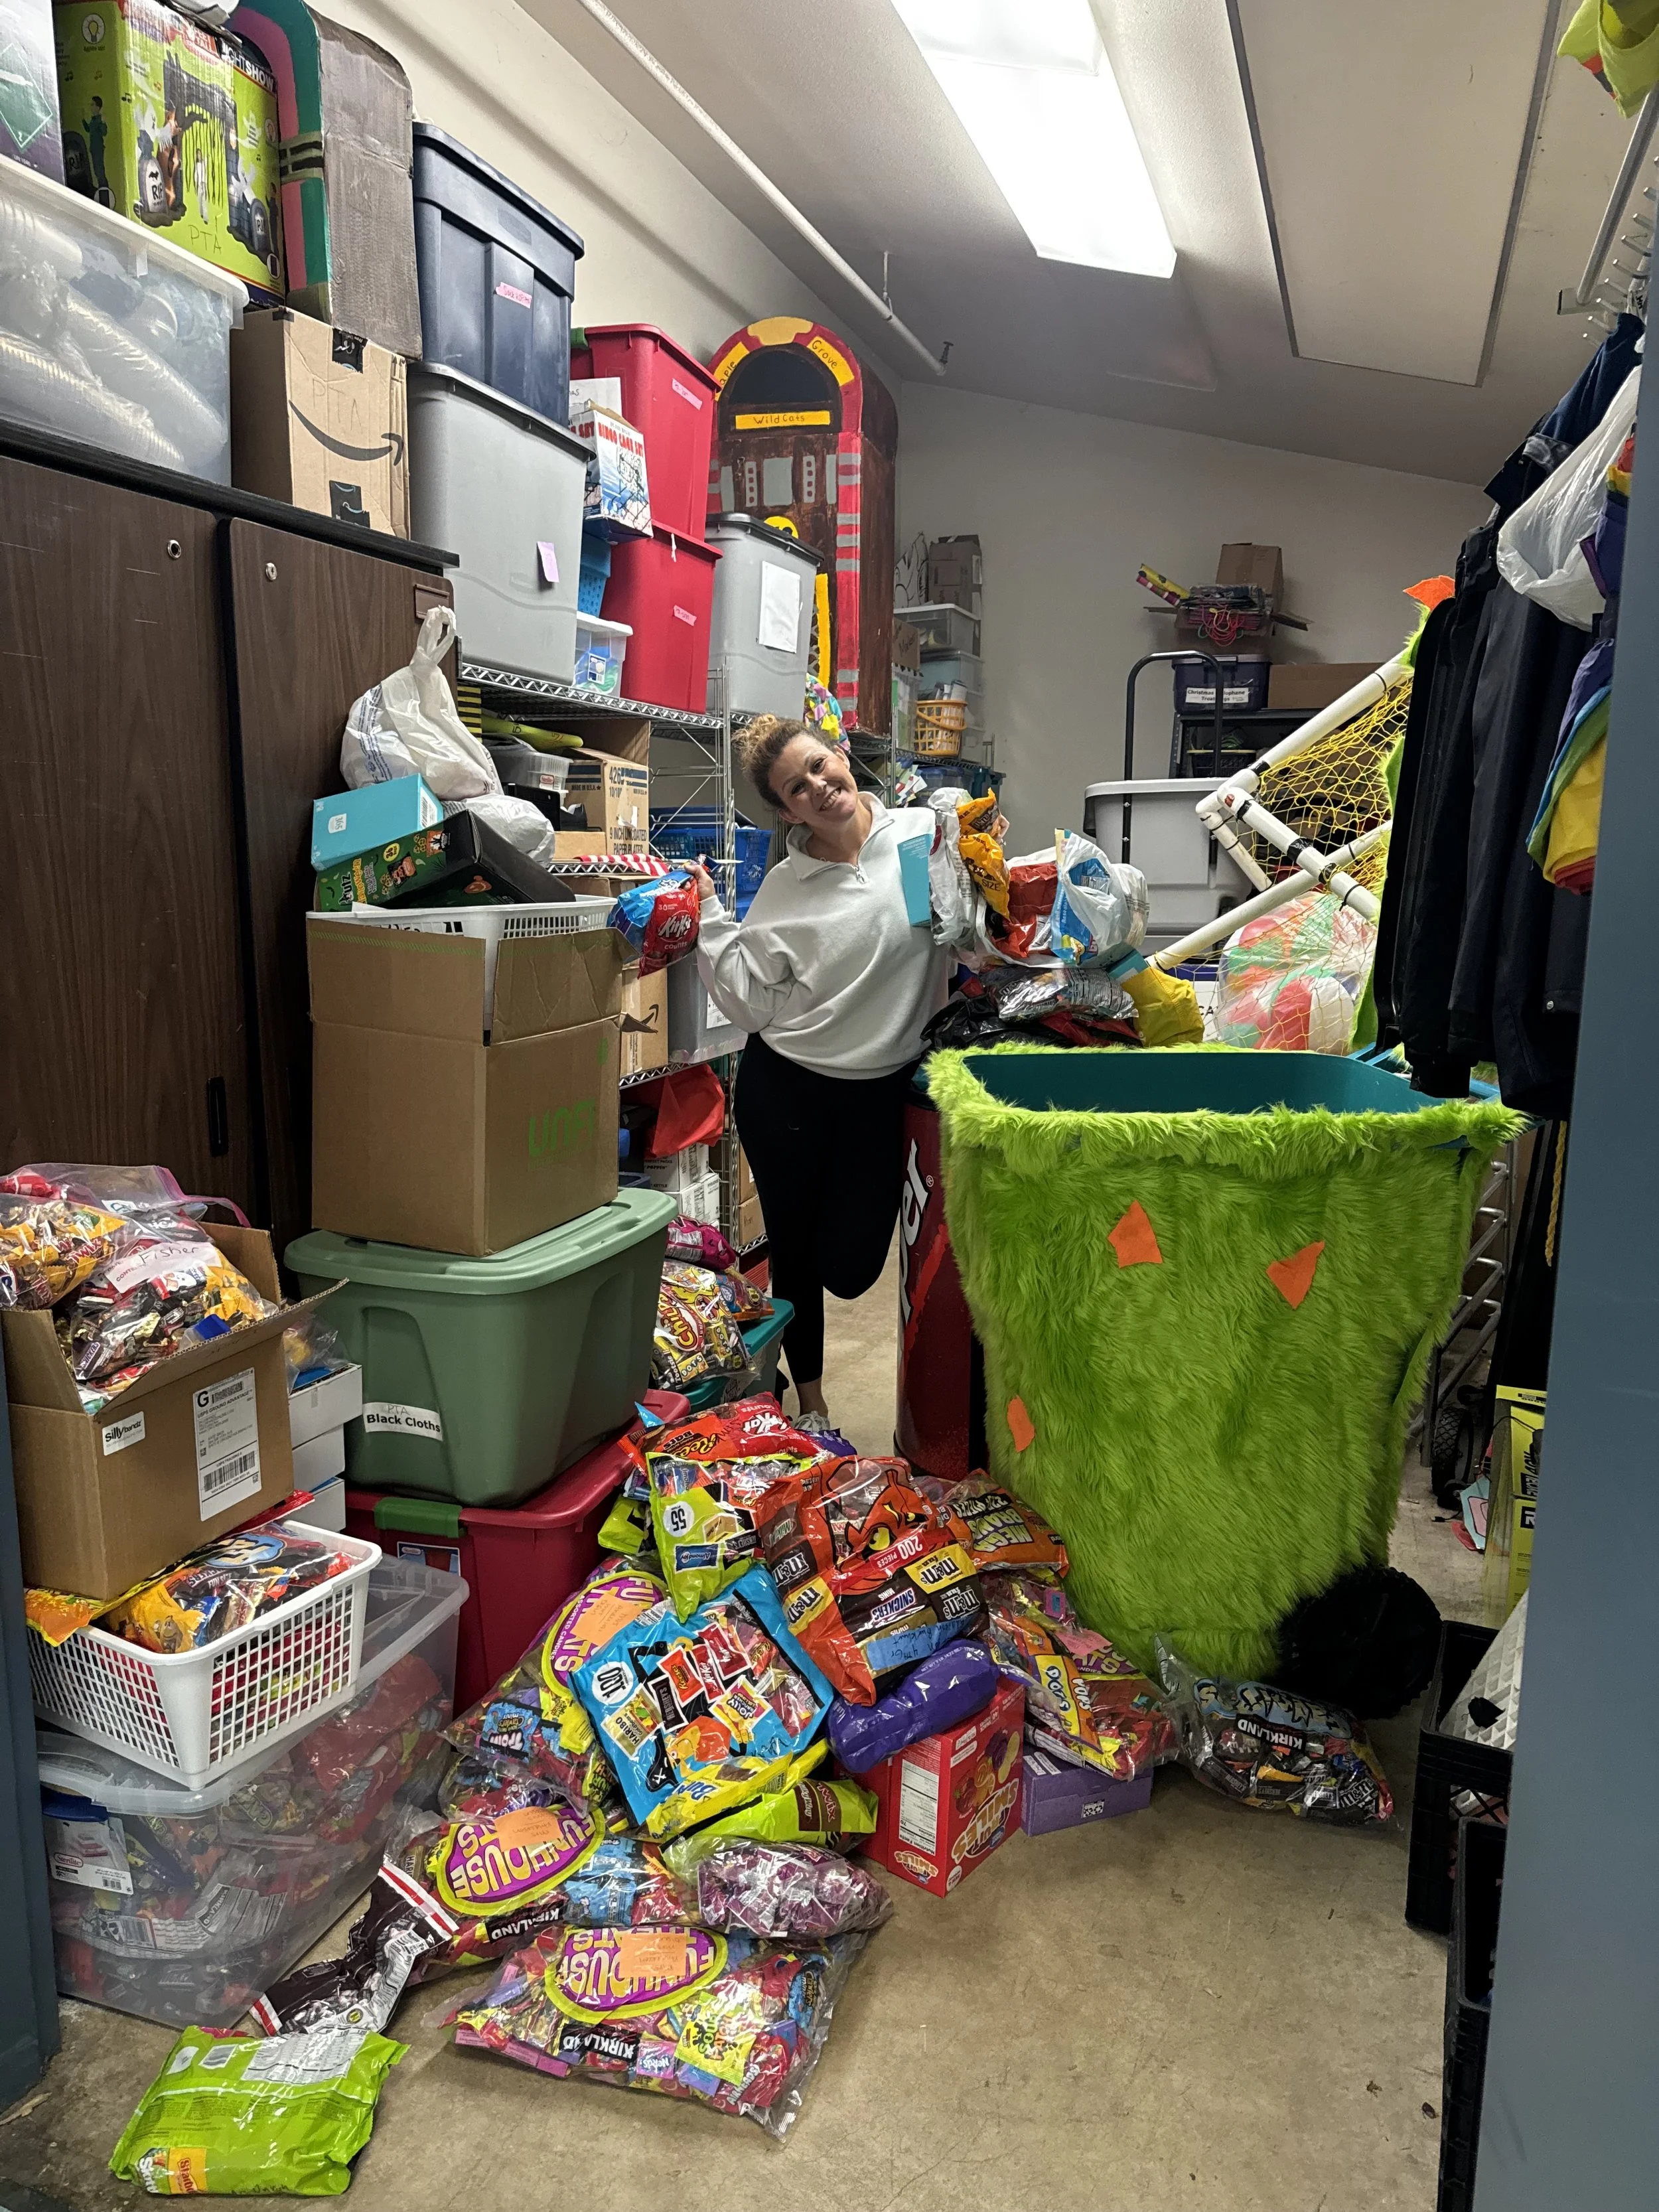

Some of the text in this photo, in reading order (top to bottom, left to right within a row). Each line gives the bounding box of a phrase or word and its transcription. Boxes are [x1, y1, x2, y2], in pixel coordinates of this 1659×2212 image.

[151, 183, 163, 200] RIP
[188, 224, 222, 254] PTA
[812, 339, 837, 370] Grove
[719, 360, 737, 386] aple
[313, 378, 362, 431] PTA
[598, 421, 618, 444] BINGO
[609, 767, 624, 784] 426
[334, 816, 345, 830] 365
[609, 827, 647, 841] 9 INCH UNCOATED
[613, 844, 627, 855] PAPER
[981, 879, 1001, 891] SIZE
[664, 941, 687, 950] counts
[67, 1238, 102, 1263] TWIX
[138, 1246, 198, 1265] Fisher
[715, 1327, 730, 1355] DOTS
[80, 1341, 100, 1369] SNICKERS
[682, 1355, 702, 1376] DOTS
[667, 1355, 682, 1383] Tootsie
[198, 1391, 210, 1408] G
[209, 1401, 226, 1413] GROUND
[388, 1404, 411, 1415] PTA
[366, 1414, 441, 1433] Black Cloths
[663, 1431, 692, 1450] Bars
[671, 1509, 687, 1531] 55
[966, 1508, 1024, 1539] BRANDS
[973, 1524, 1033, 1552] MEGA
[877, 1536, 923, 1568] 200 PIECES
[563, 1594, 585, 1630] ASSORTED
[871, 1587, 914, 1621] SNICKERS
[890, 1623, 908, 1635] minis
[549, 1630, 566, 1660] CANDIES
[1045, 1665, 1070, 1711] DOTS
[1072, 1678, 1091, 1712] POPS
[726, 1698, 754, 1719] JOLLY
[733, 1696, 755, 1713] RANCHER
[498, 1715, 524, 1728] Crawlers
[615, 1716, 640, 1746] HARIBO
[1238, 1719, 1303, 1749] KIRKLAND
[817, 1783, 836, 1822] TWIX
[952, 1779, 1018, 1863] SMILES
[899, 1834, 935, 1854] Nutrition Facts
[918, 1828, 935, 1838] Calories
[57, 1854, 82, 1866] Sterilite
[405, 1855, 416, 1878] HARI
[894, 1851, 938, 1876] SMILES
[642, 2056, 669, 2069] Nerds
[726, 2064, 760, 2104] AIRHEADS
